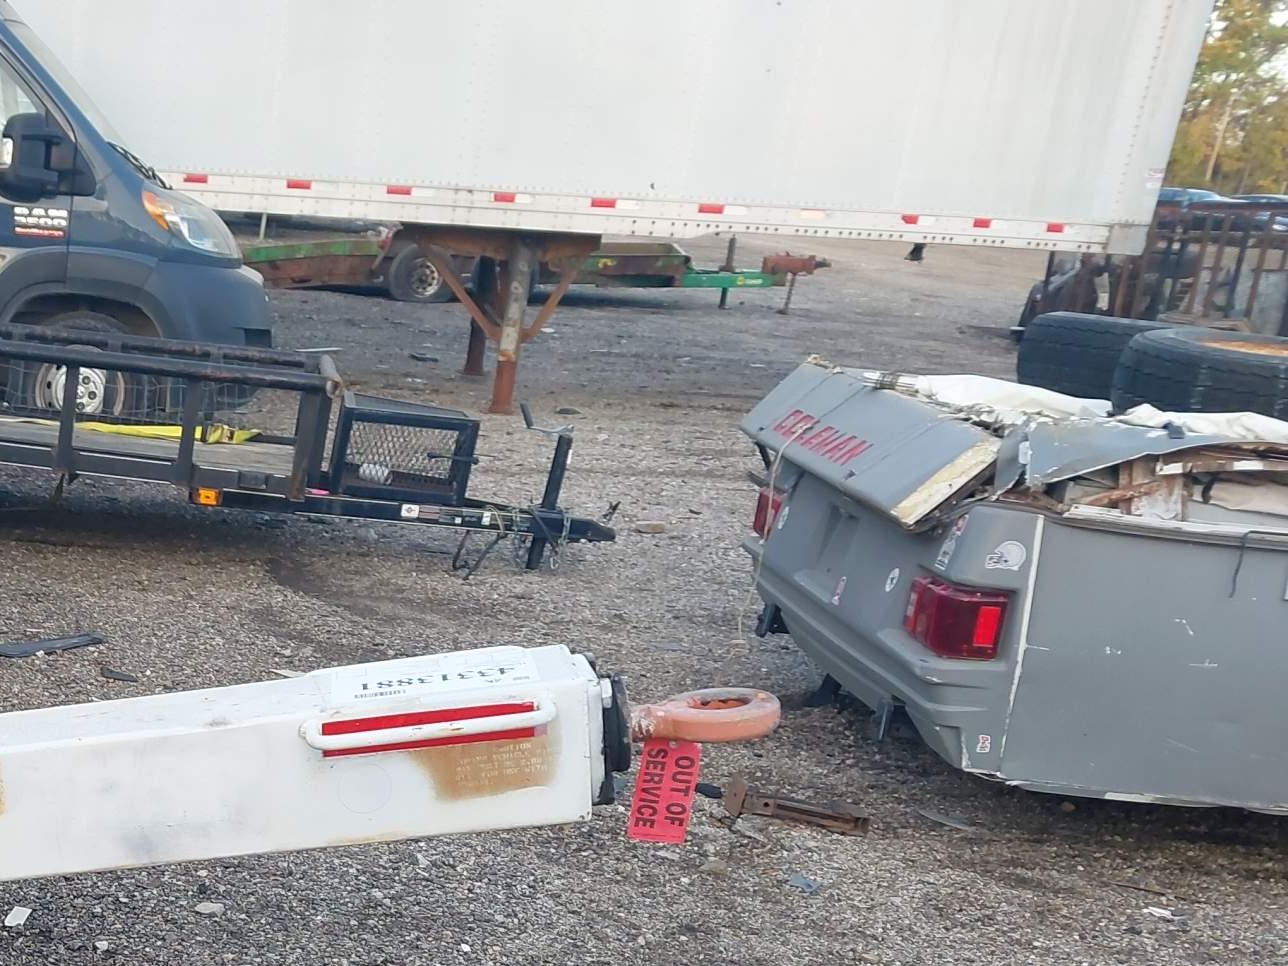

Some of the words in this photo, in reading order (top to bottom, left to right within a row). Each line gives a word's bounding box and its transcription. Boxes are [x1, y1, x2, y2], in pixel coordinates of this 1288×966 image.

[774, 409, 875, 466] COLEMAN
[634, 748, 669, 829] SERVICE
[669, 756, 696, 798] OUT
[664, 802, 688, 827] OF
